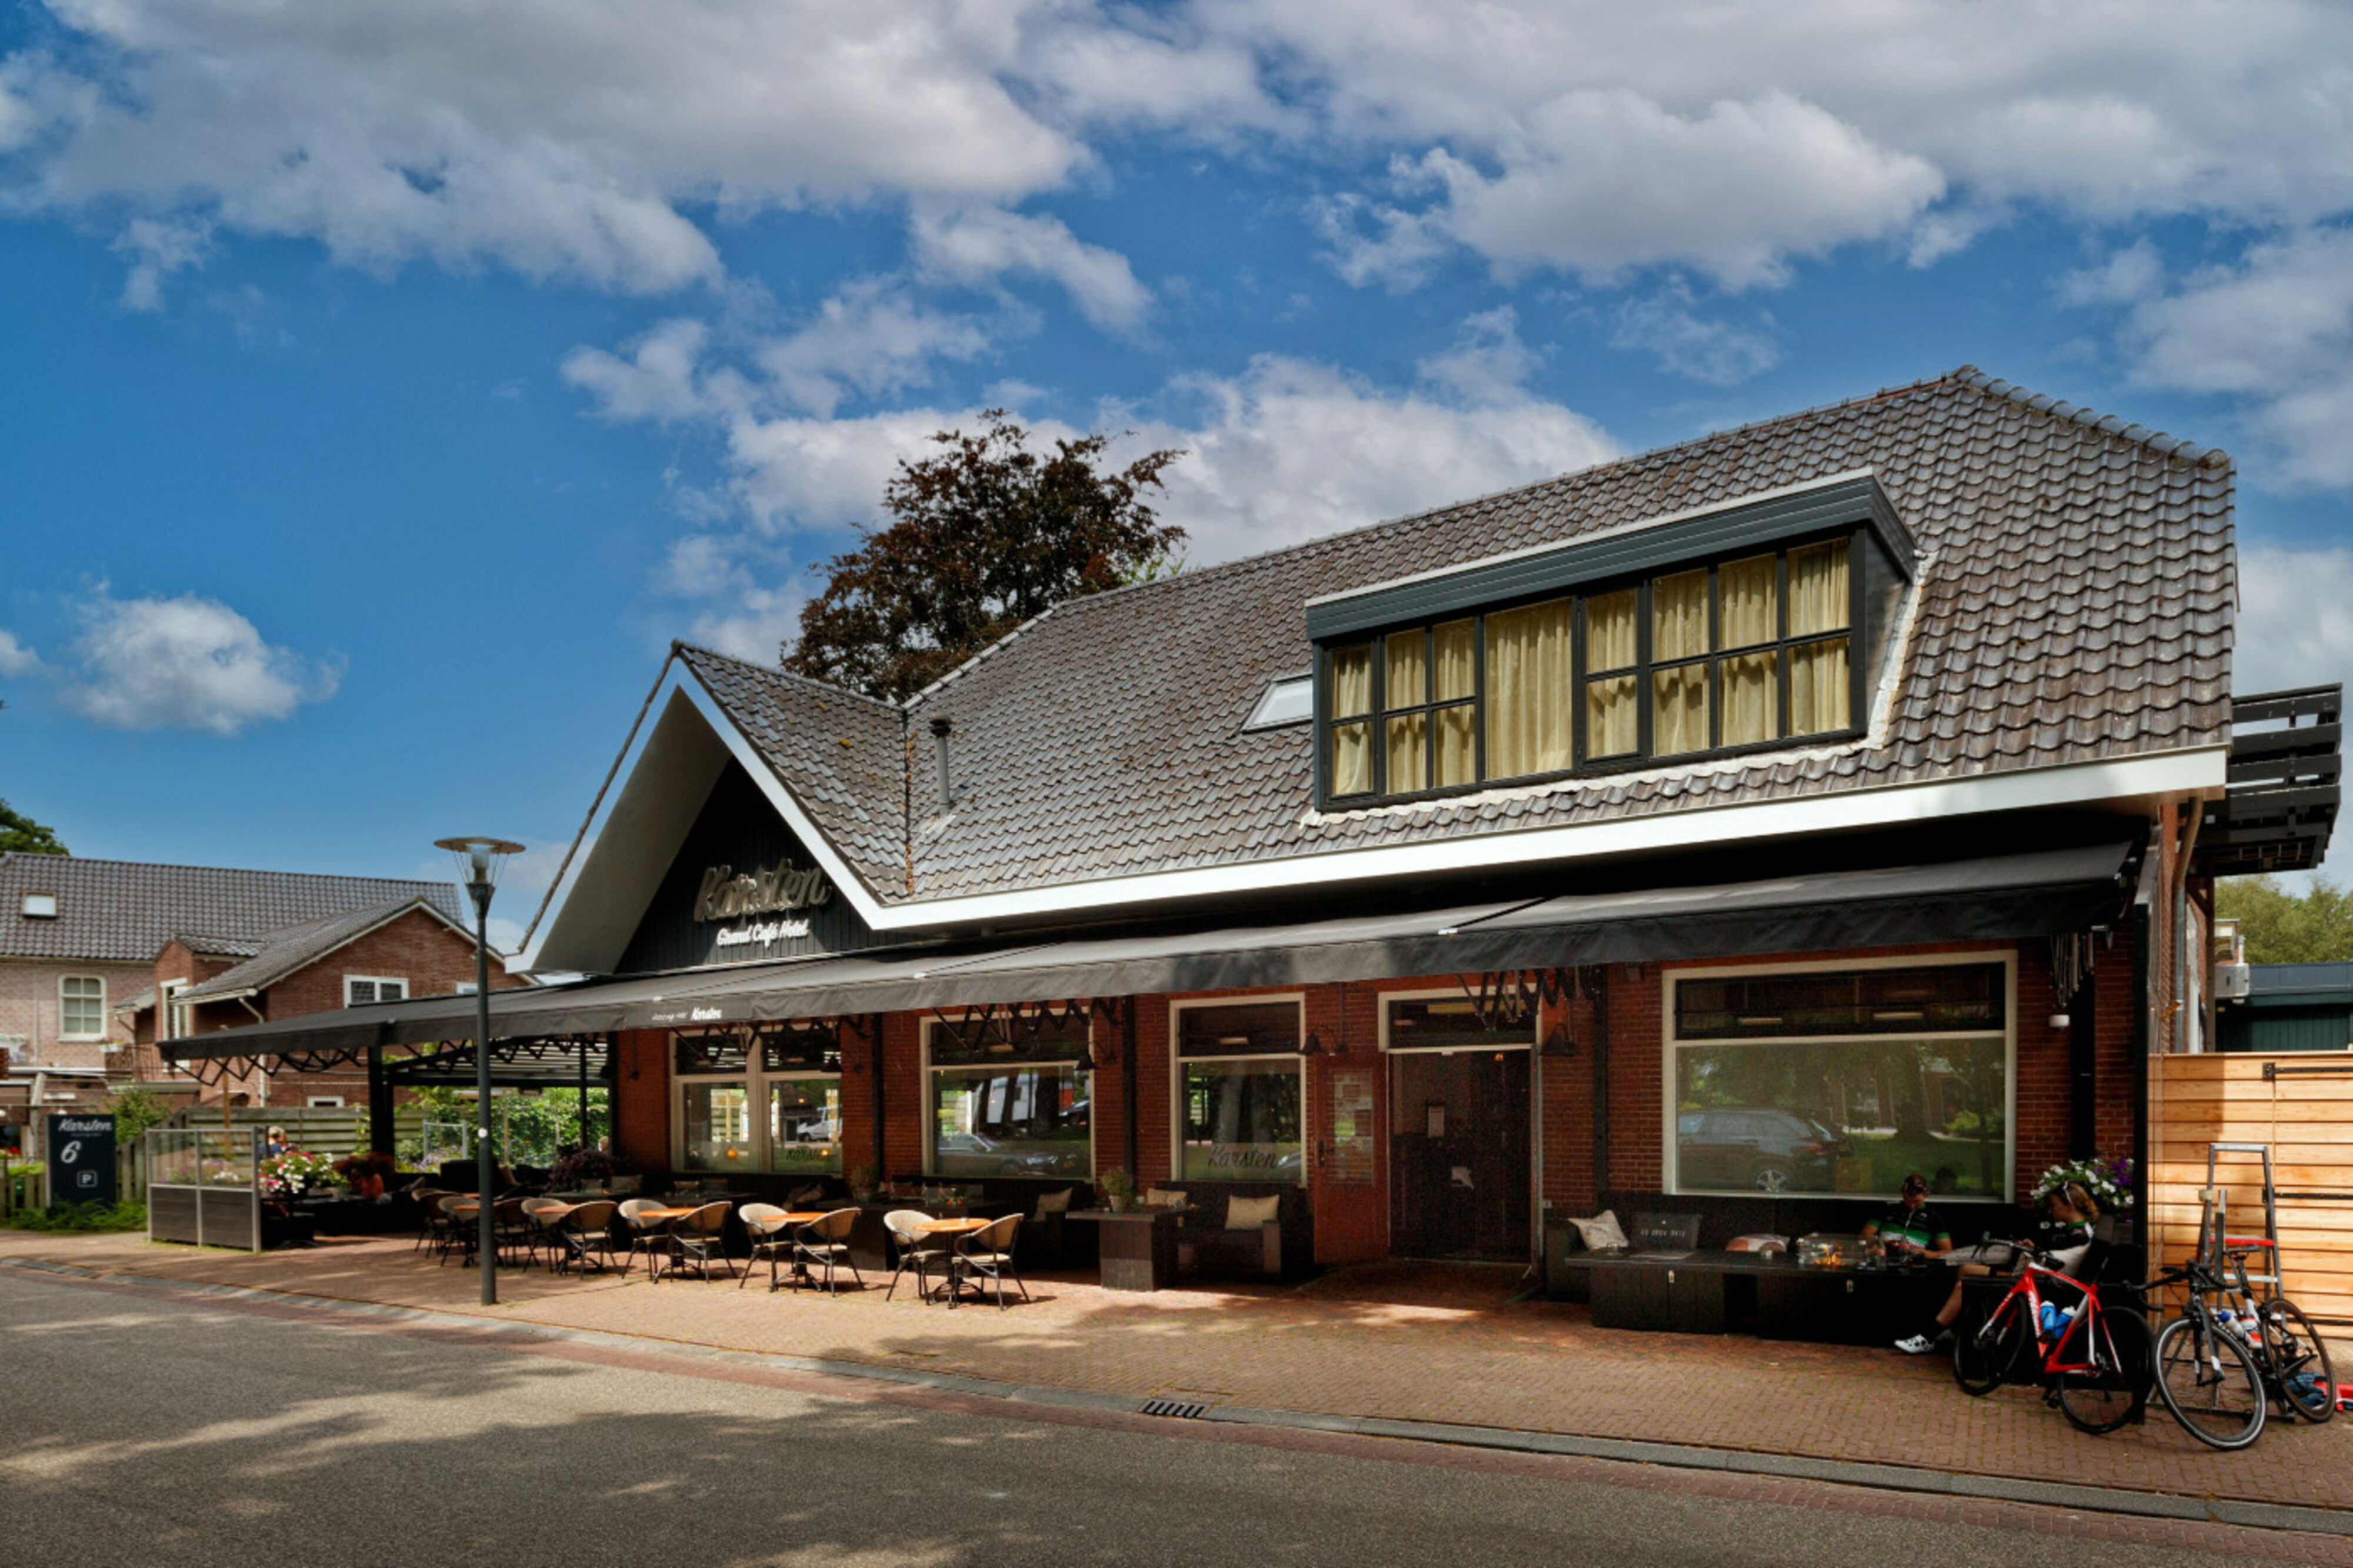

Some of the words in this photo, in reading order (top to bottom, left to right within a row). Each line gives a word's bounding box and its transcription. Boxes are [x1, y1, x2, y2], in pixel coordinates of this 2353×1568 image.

[694, 858, 832, 922] Karsten
[716, 924, 752, 946] Grand
[779, 918, 809, 938] Hotel
[58, 1119, 113, 1132] Karsten
[61, 1140, 82, 1163] 6
[1208, 1145, 1278, 1168] Karsten
[82, 1174, 92, 1183] P
